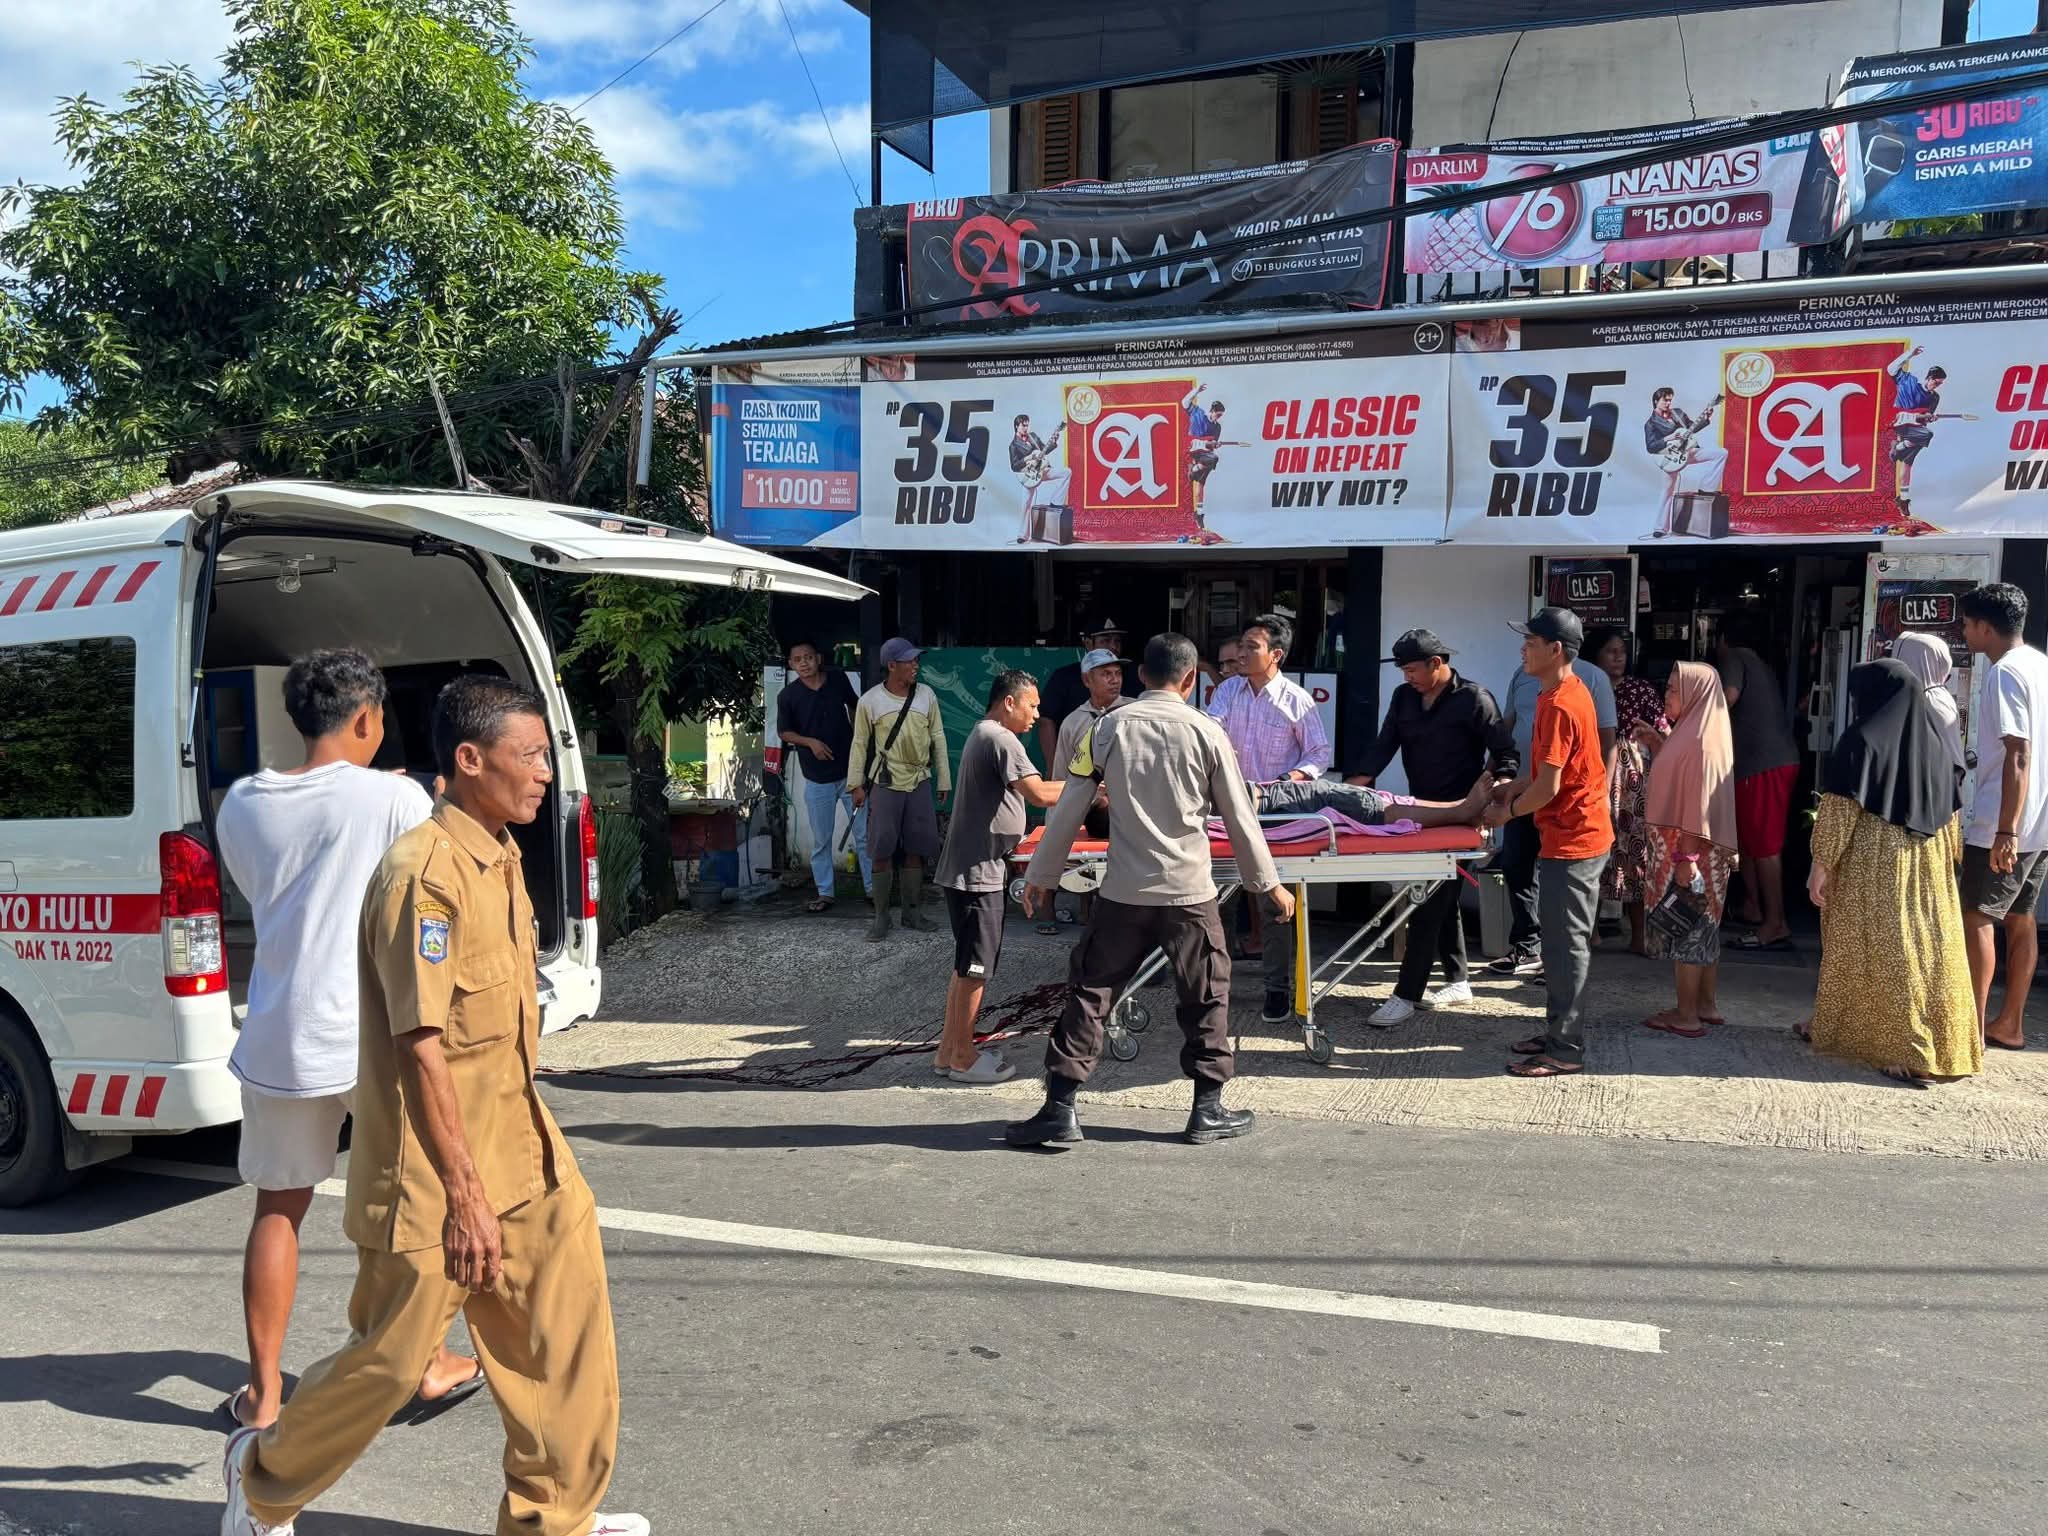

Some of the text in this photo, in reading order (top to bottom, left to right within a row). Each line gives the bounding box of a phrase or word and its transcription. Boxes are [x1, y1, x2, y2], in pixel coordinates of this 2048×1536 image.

[1928, 61, 1956, 71] SAYA
[1958, 54, 2010, 68] TERKENA
[1916, 98, 2022, 142] 30 RIBU
[1915, 138, 2032, 162] GARIS MERAH
[1412, 158, 1478, 177] DJARUM
[1611, 152, 1759, 196] NANAS
[1915, 157, 2032, 180] ISINYA A MILD
[1234, 220, 1281, 238] HADIR
[1632, 209, 1644, 217] RP
[1644, 202, 1730, 232] 15.000
[1255, 254, 1359, 272] DIBUNGKUS SATUAN
[1800, 293, 1900, 310] PERINGATAN:
[1592, 326, 1631, 335] KARENA
[1685, 320, 1710, 329] SAYA
[1711, 316, 1757, 327] TERKENA
[1760, 314, 1801, 324] KANKER
[1803, 308, 1885, 320] TENGGOROKAN.
[1888, 305, 1936, 315] LAYANAN
[1938, 301, 1990, 312] BERHENTI
[1993, 298, 2048, 309] MEROKOK
[1604, 333, 1652, 344] DILARANG
[1654, 331, 1698, 340] MENJUAL
[1701, 328, 1722, 337] DAN
[1724, 324, 1770, 336] MEMBERI
[1772, 322, 1812, 332] KEPADA
[1814, 320, 1851, 329] ORANG
[1866, 316, 1904, 326] BAWAH
[1906, 314, 1931, 324] USIA
[1933, 314, 1944, 322] 21
[1948, 312, 1982, 321] TAHUN
[1985, 310, 2008, 319] DAN
[1114, 339, 1188, 352] PERINGATAN:
[1418, 332, 1440, 343] 21+
[967, 360, 995, 369] KARENA
[1053, 356, 1085, 365] TERKENA
[1118, 351, 1176, 361] TENGGOROKAN.
[1178, 348, 1213, 357] LAYANAN
[1214, 345, 1253, 355] BERHENTI
[1254, 343, 1294, 353] MEROKOK
[976, 367, 1011, 376] DILARANG
[1012, 366, 1044, 374] MENJUAL
[1062, 364, 1095, 372] MEMBERI
[1096, 361, 1125, 370] KEPADA
[1163, 358, 1191, 367] BAWAH
[1221, 355, 1247, 363] TAHUN
[1249, 353, 1266, 362] DAN
[1267, 351, 1316, 361] PEREMPUAN
[1317, 349, 1343, 358] HAMIL
[1735, 358, 1765, 384] 89
[744, 402, 819, 419] RASA IKONIK
[1262, 394, 1420, 440] CLASSIC
[1479, 370, 1626, 468] RP 35
[742, 423, 798, 438] SEMAKIN
[886, 400, 994, 482] RP 35
[1758, 382, 1868, 486] A
[743, 440, 819, 464] TERJAGA
[1092, 412, 1170, 501] A
[1272, 443, 1408, 474] ON REPEAT
[756, 477, 824, 505] 11.000
[1272, 478, 1408, 508] WHY NOT?
[1486, 471, 1602, 516] RIBU
[894, 486, 979, 524] RIBU
[39, 896, 113, 930] HULU
[50, 941, 71, 961] TA
[76, 941, 113, 962] 2022
